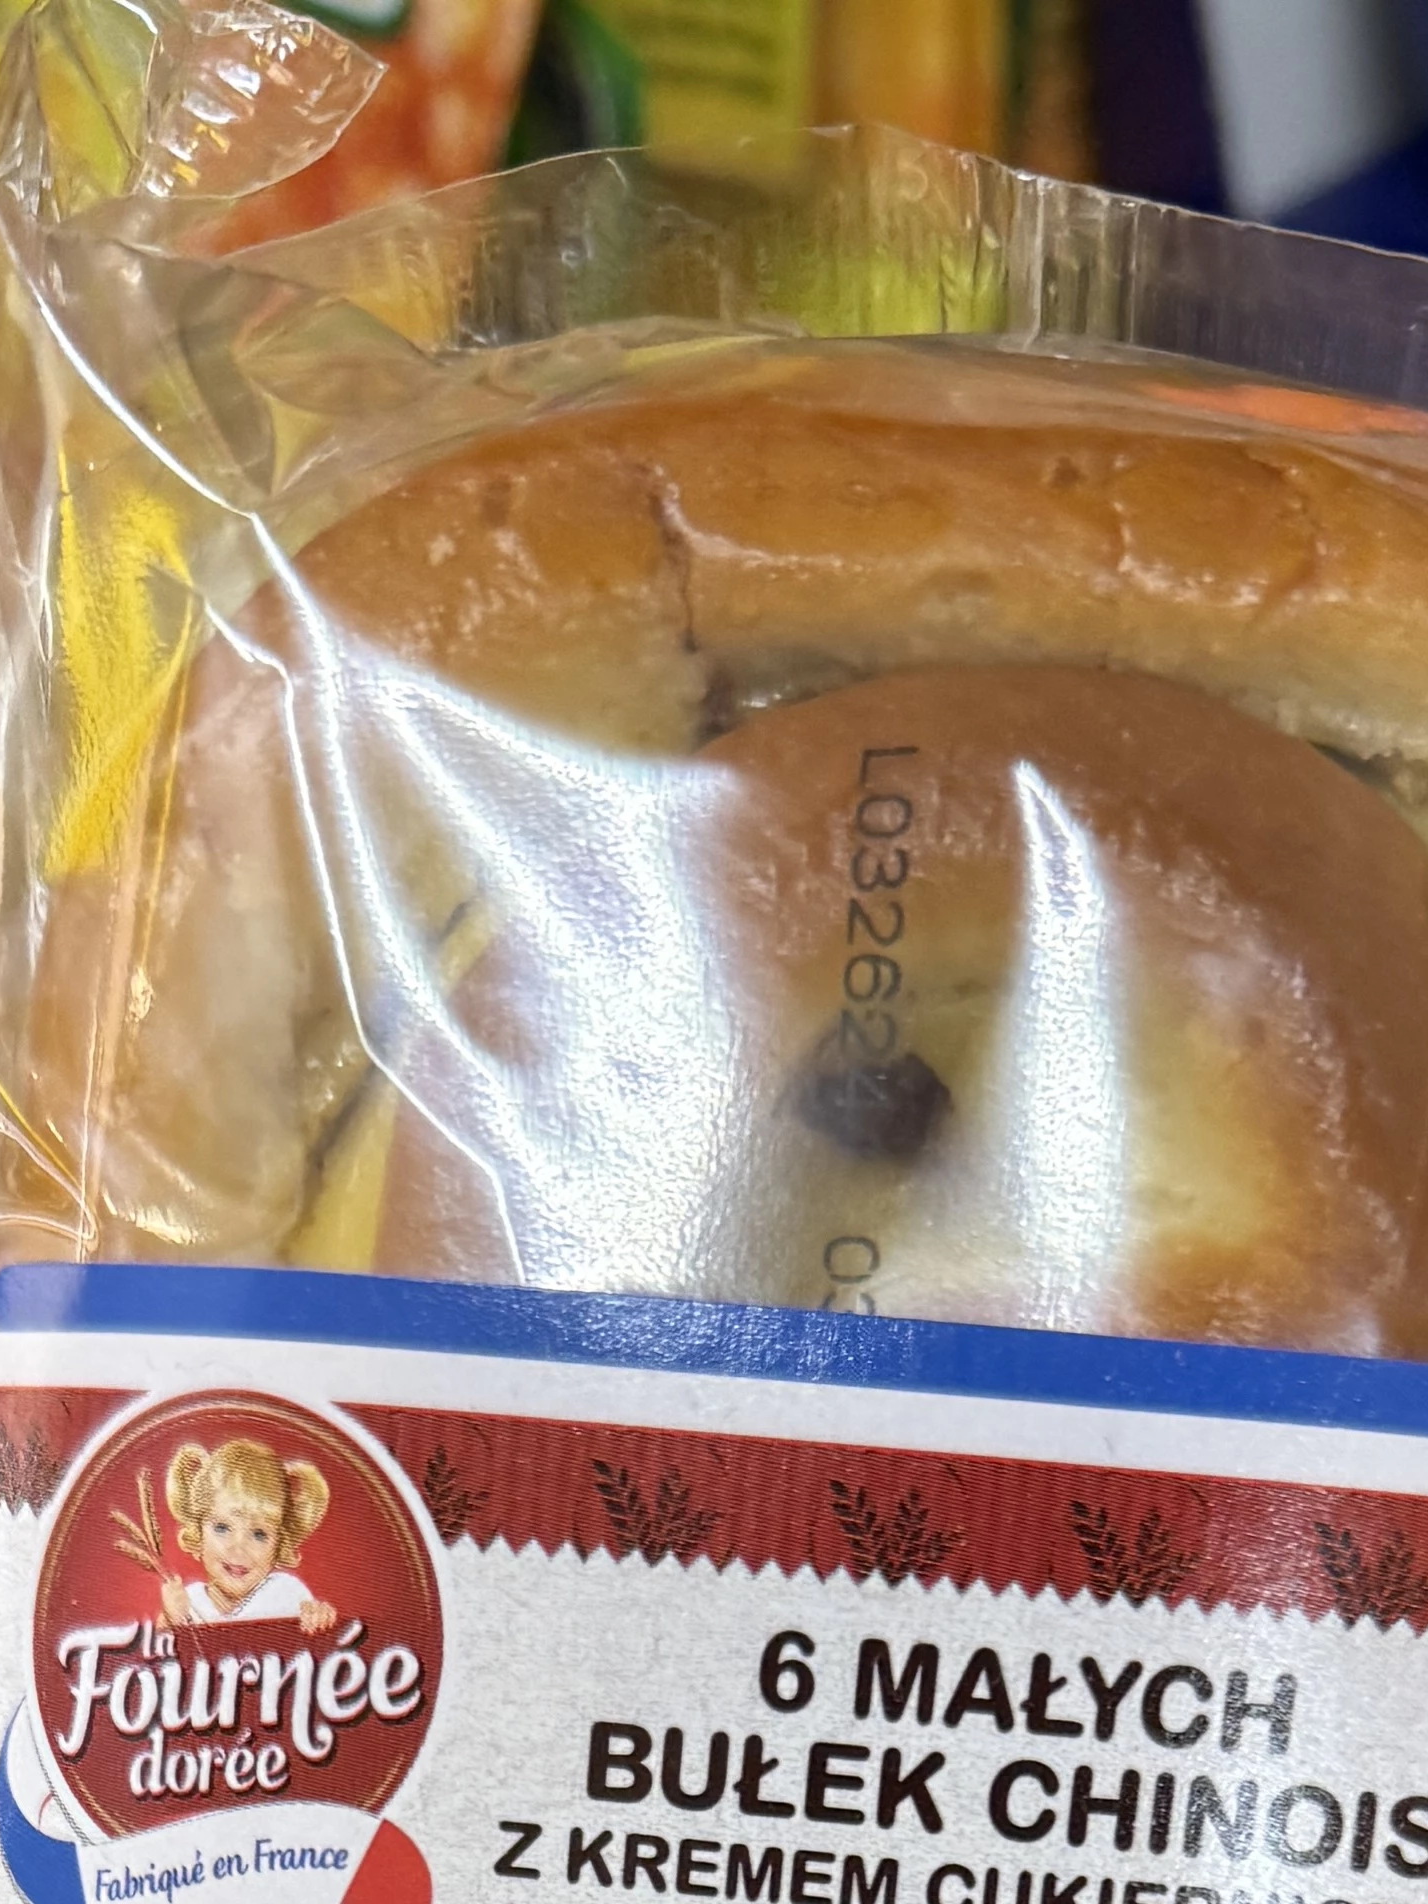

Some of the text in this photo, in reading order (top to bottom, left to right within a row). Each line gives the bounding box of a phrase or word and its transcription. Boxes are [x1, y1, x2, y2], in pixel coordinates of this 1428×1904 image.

[140, 1621, 175, 1659] la
[54, 1619, 421, 1759] Fournée
[759, 1630, 1299, 1756] 6 MAŁYCH
[129, 1730, 290, 1796] dorée
[586, 1720, 946, 1834] BUŁEK
[94, 1838, 349, 1903] Fabriqué en France
[494, 1820, 543, 1880] Z
